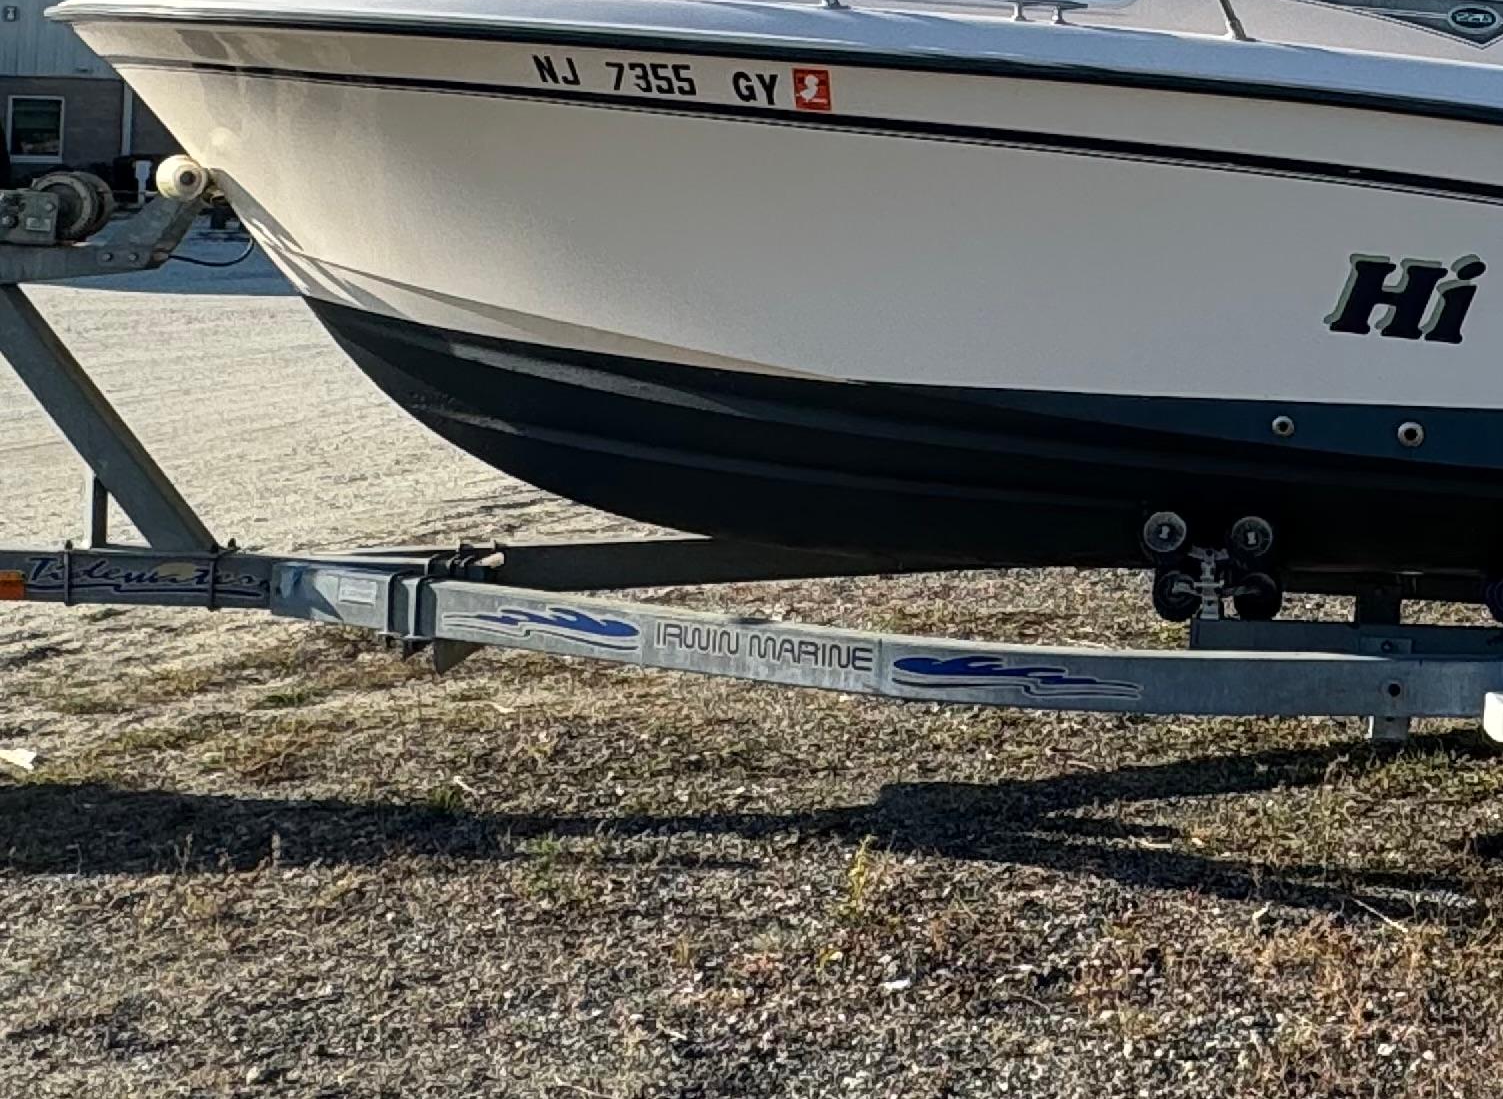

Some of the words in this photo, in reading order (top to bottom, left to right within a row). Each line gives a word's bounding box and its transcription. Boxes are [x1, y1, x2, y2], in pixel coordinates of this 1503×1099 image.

[532, 54, 581, 86] NJ
[605, 61, 697, 96] 7355
[732, 71, 778, 106] GY
[1323, 253, 1487, 344] Hi
[655, 621, 741, 655] IRWIN
[749, 633, 873, 671] MARINE
